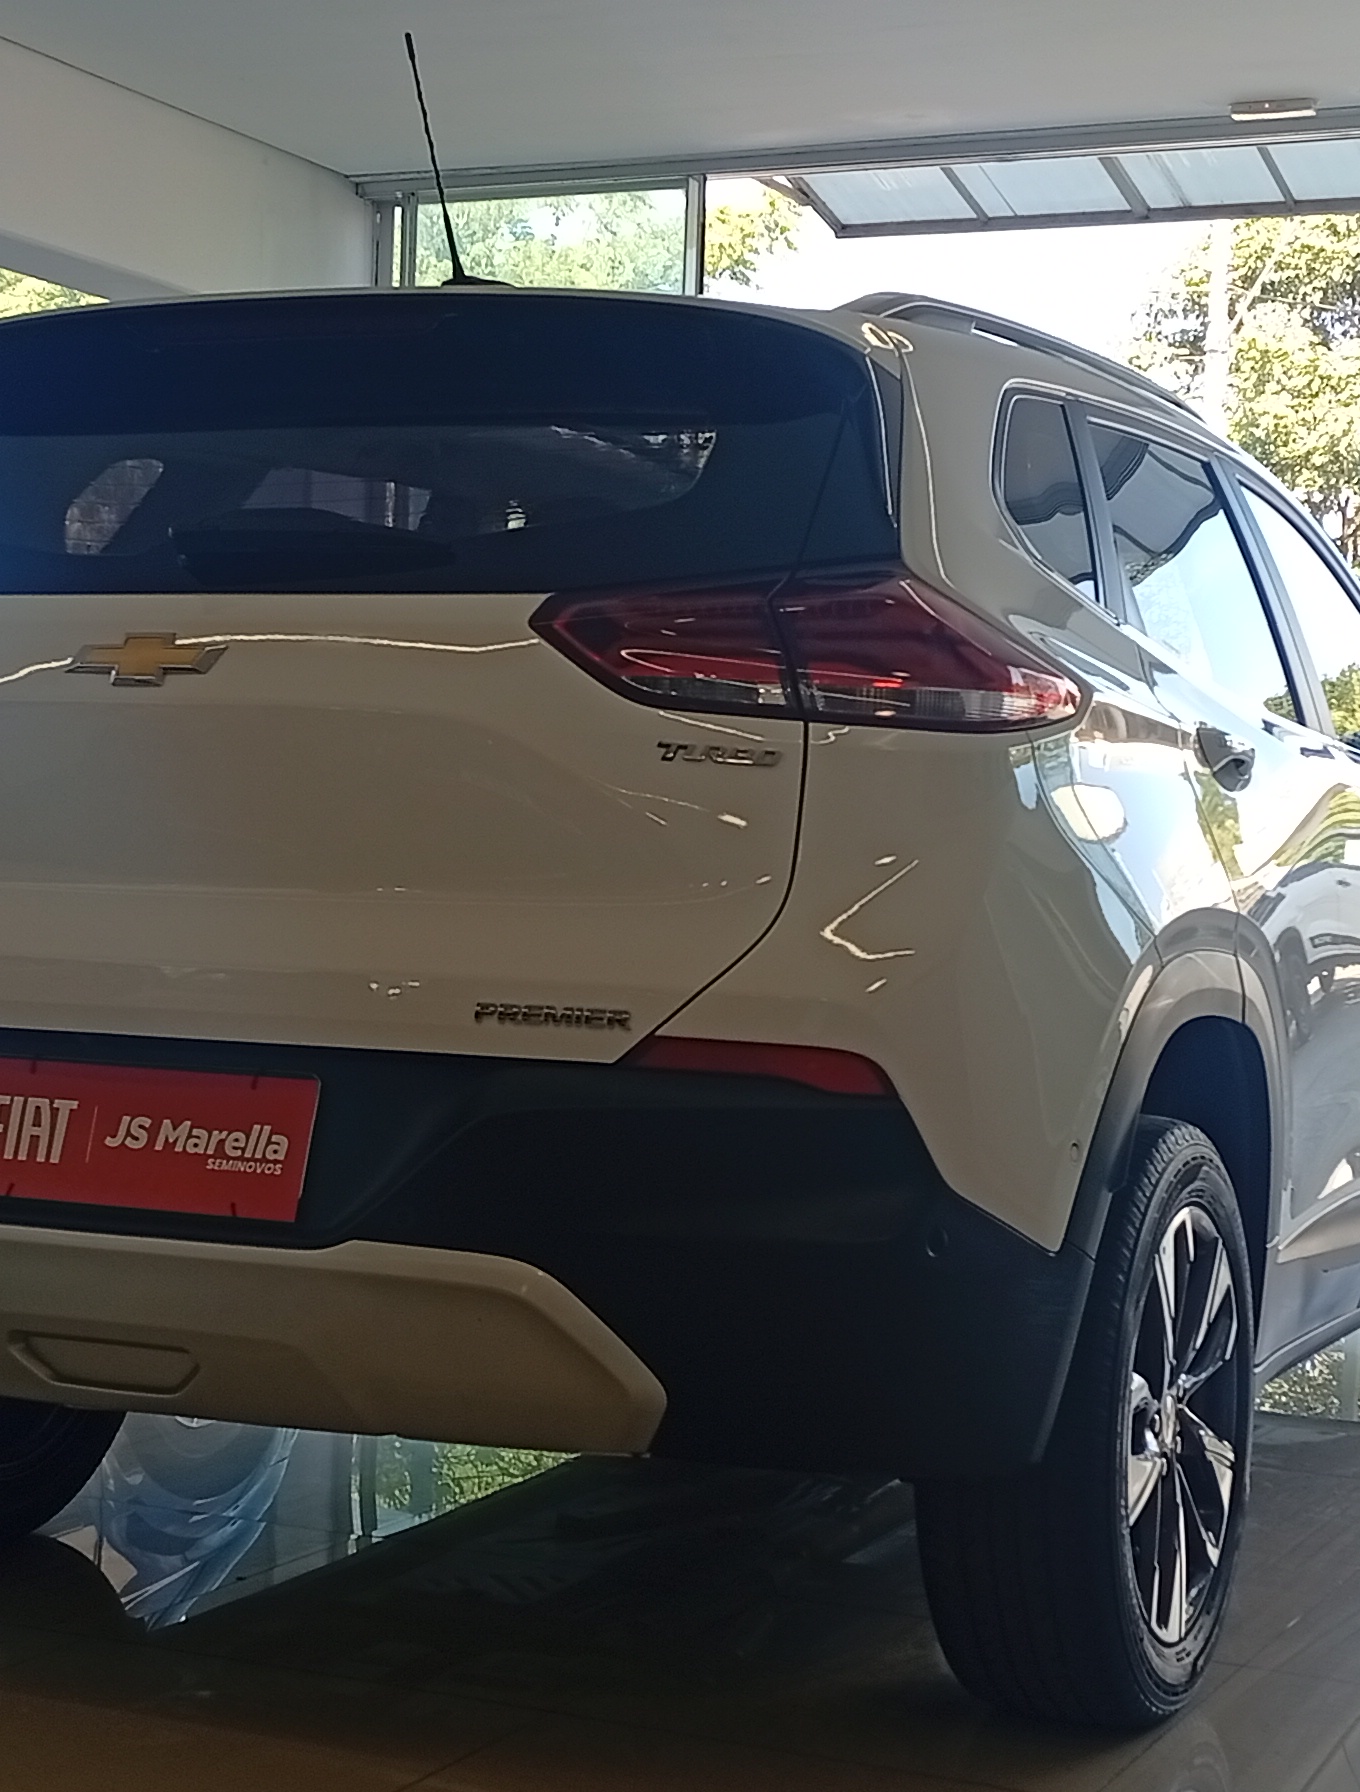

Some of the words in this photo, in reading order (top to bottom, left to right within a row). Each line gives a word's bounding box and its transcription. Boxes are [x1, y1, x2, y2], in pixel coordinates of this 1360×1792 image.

[474, 1002, 632, 1031] PREMIER
[104, 1115, 153, 1150] JS
[154, 1119, 289, 1161] Marella
[206, 1158, 283, 1176] SEMINOVOS
